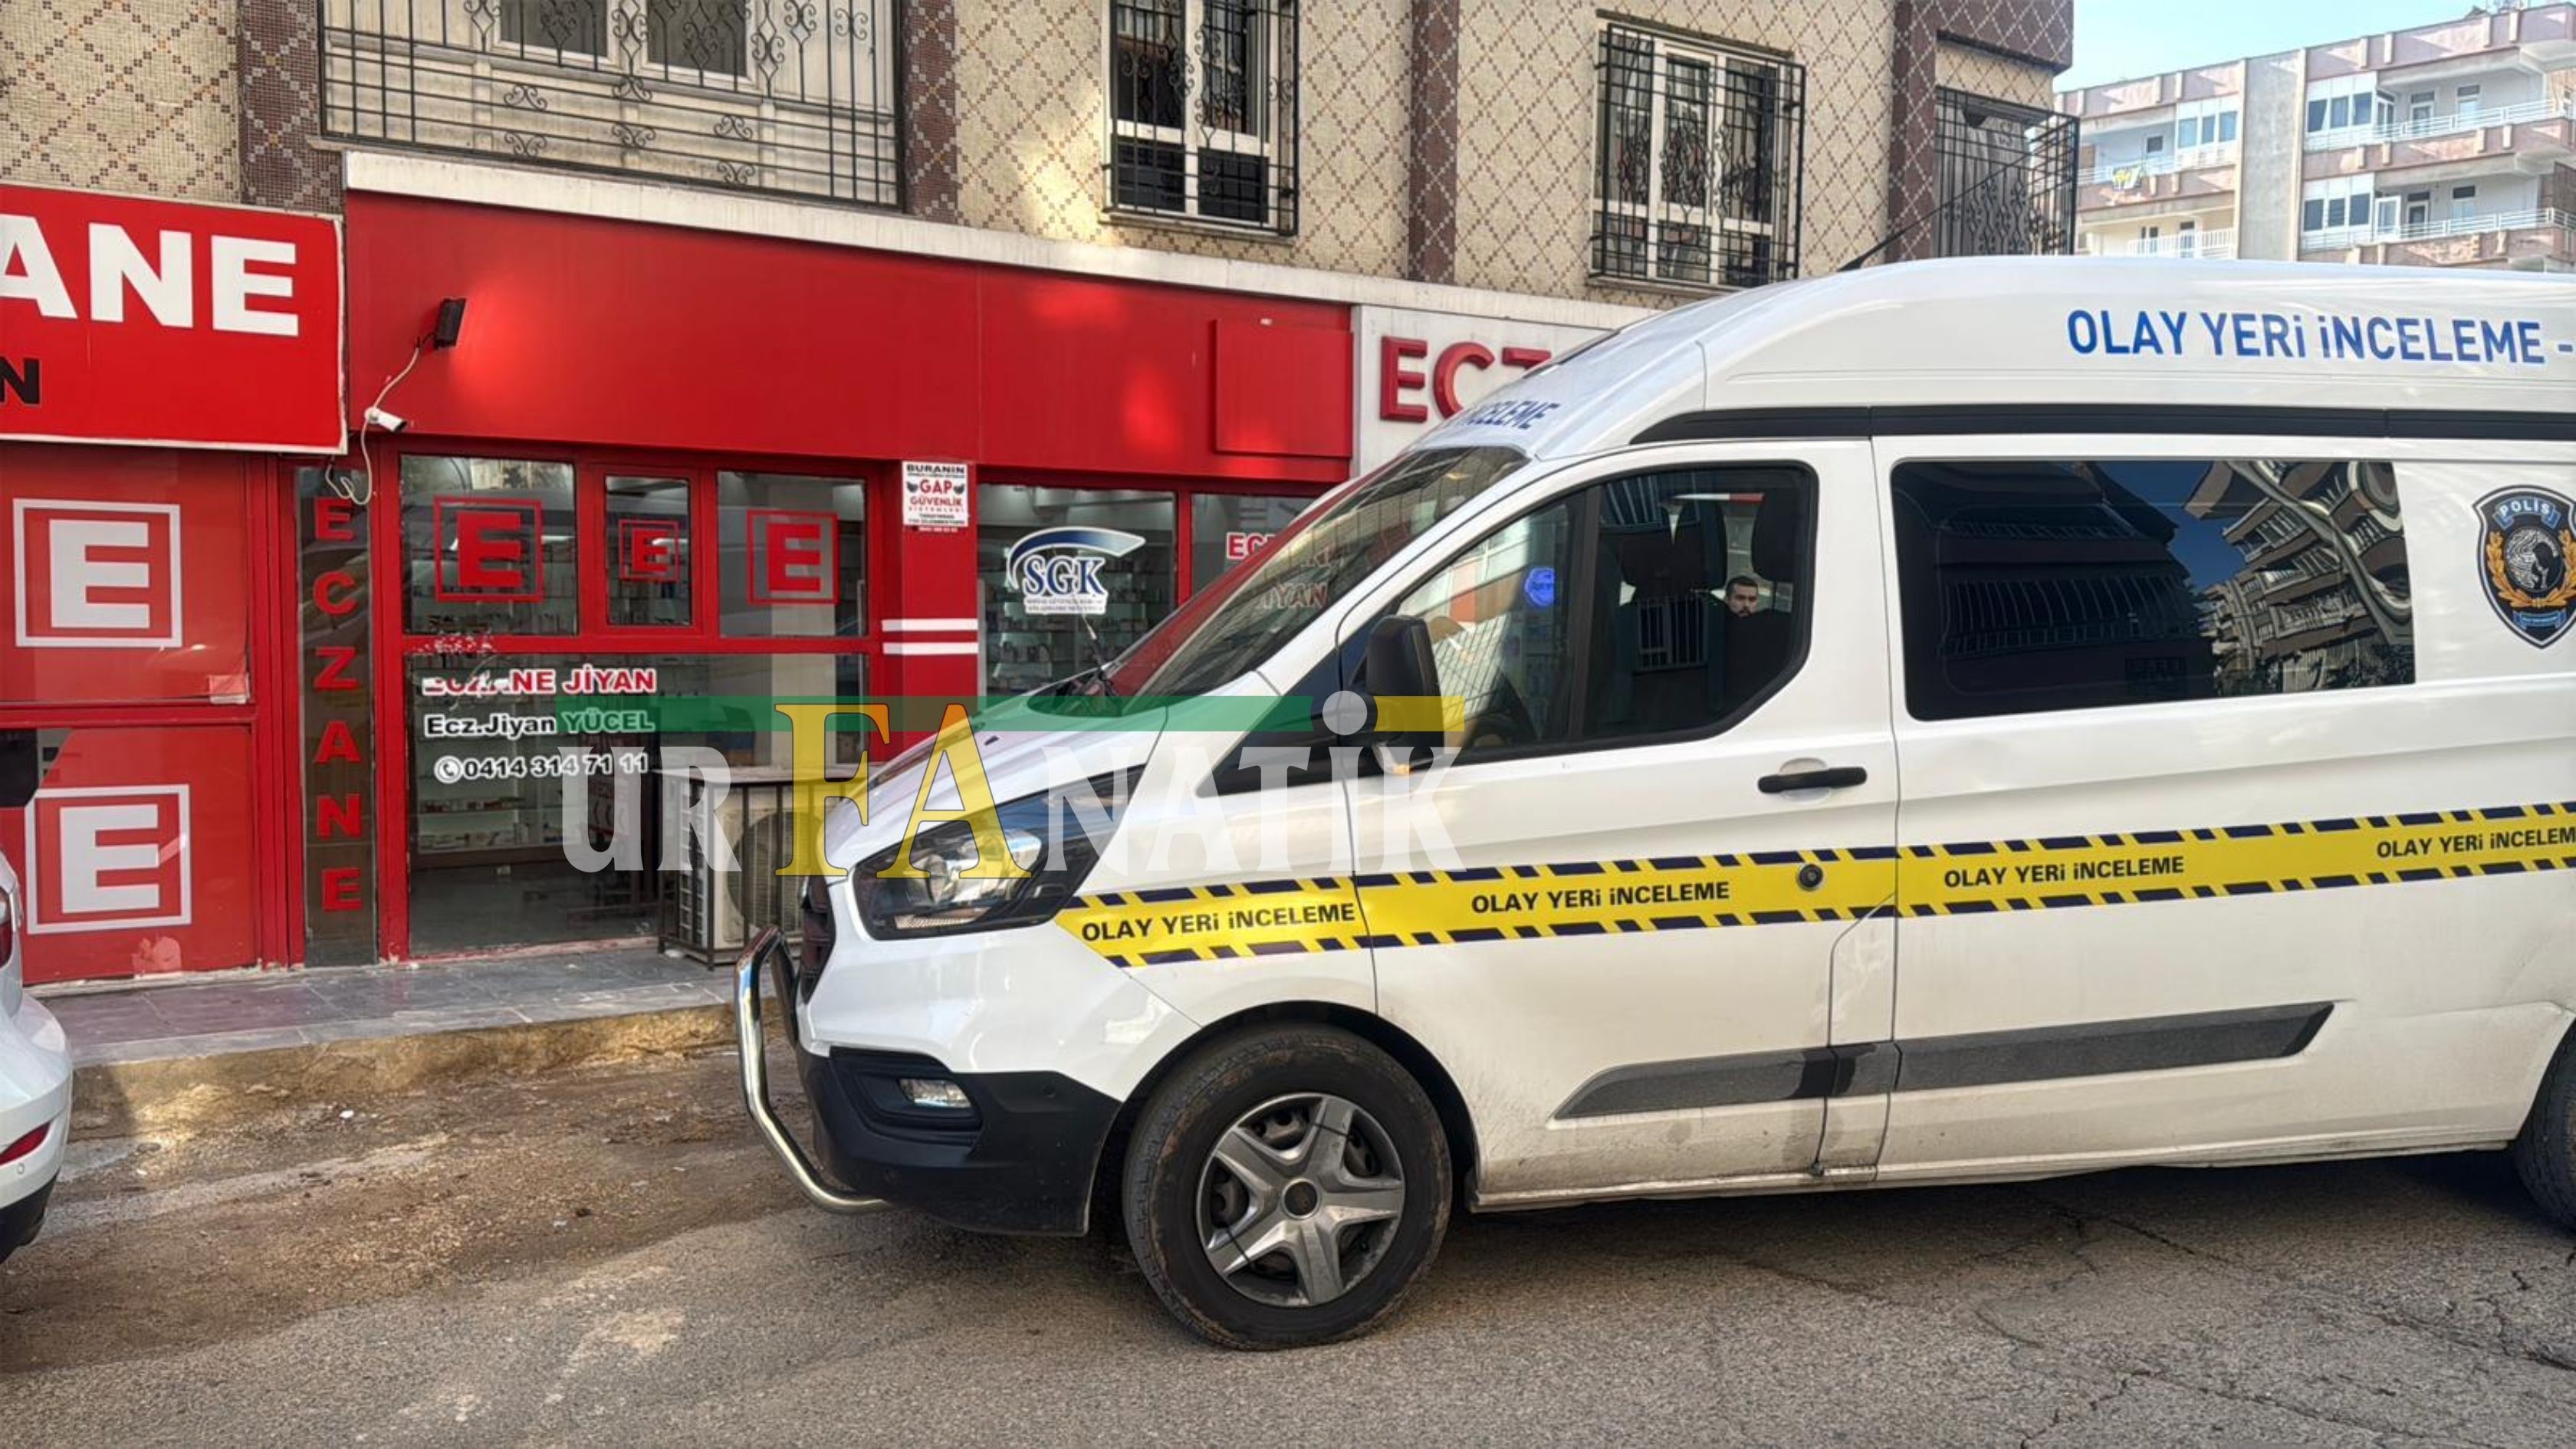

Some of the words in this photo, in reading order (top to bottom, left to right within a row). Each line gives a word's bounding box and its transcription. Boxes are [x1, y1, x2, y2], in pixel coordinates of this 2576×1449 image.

[2066, 309, 2188, 356] OLAY
[920, 479, 952, 494] GAP
[456, 511, 524, 590] E
[630, 529, 669, 573] E
[766, 523, 822, 593] E
[50, 520, 150, 629] E
[1024, 557, 1105, 595] SGK
[562, 665, 656, 693] JİYAN
[425, 713, 556, 740] Ecz.Jiyan
[560, 708, 656, 734] YÜCEL
[462, 755, 526, 778] 0414
[531, 754, 579, 776] 314
[583, 754, 613, 774] 71
[619, 752, 649, 772] 11
[61, 804, 160, 913] E
[2375, 838, 2432, 858] OLAY
[1944, 867, 2006, 888] OLAY
[1471, 892, 1539, 914] OLAY
[1081, 918, 1152, 941] OLAY
